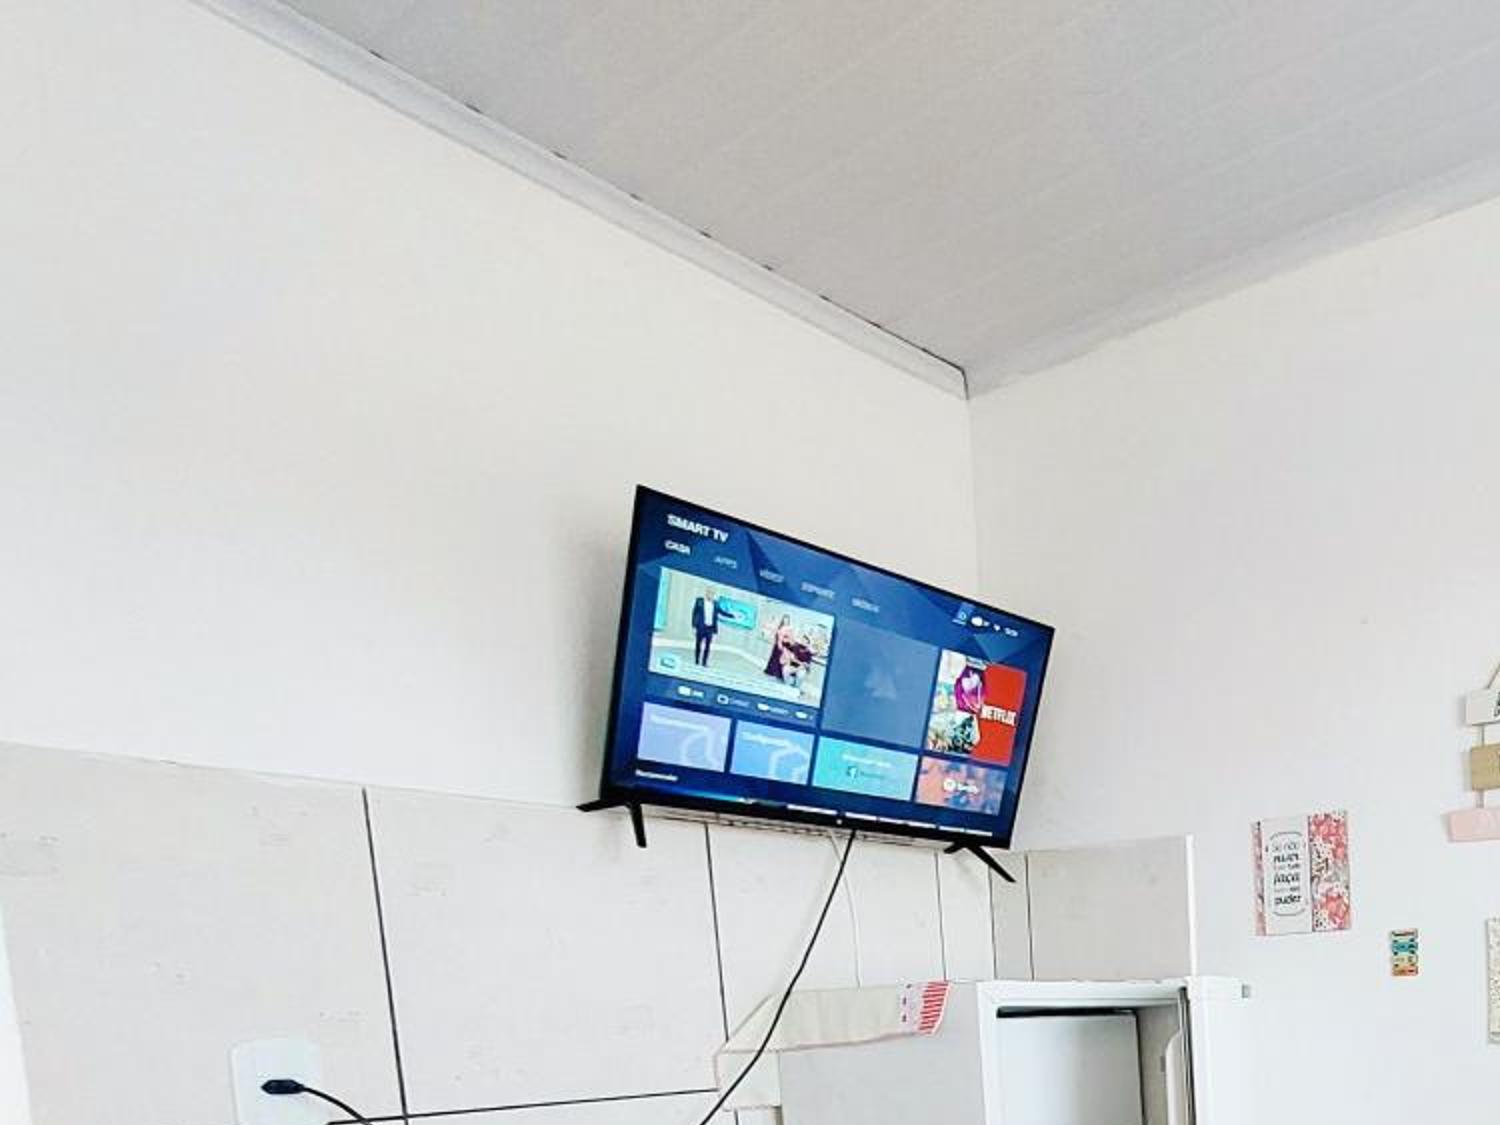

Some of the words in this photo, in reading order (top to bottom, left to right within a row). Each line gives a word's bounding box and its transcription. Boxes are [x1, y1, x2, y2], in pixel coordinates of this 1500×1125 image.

[667, 513, 710, 537] SMART
[713, 529, 729, 543] TV
[980, 704, 1017, 727] NETFLIX
